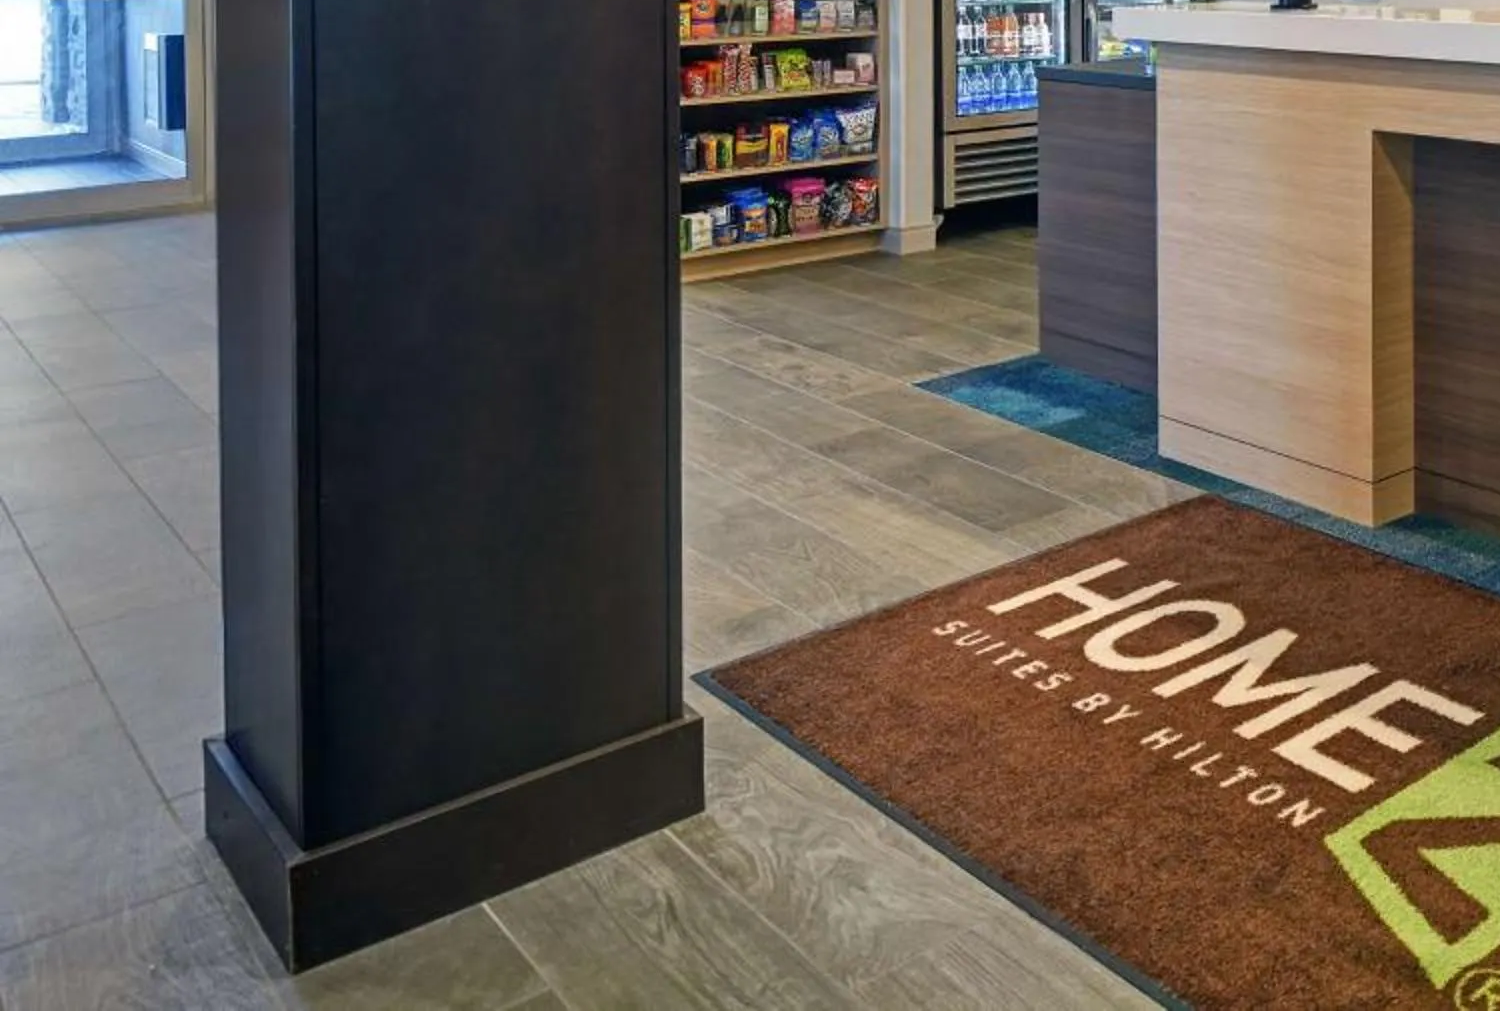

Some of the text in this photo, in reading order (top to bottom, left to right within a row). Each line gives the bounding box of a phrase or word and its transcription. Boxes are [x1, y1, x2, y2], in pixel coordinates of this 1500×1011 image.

[932, 619, 1326, 829] SUITES BY HILTON
